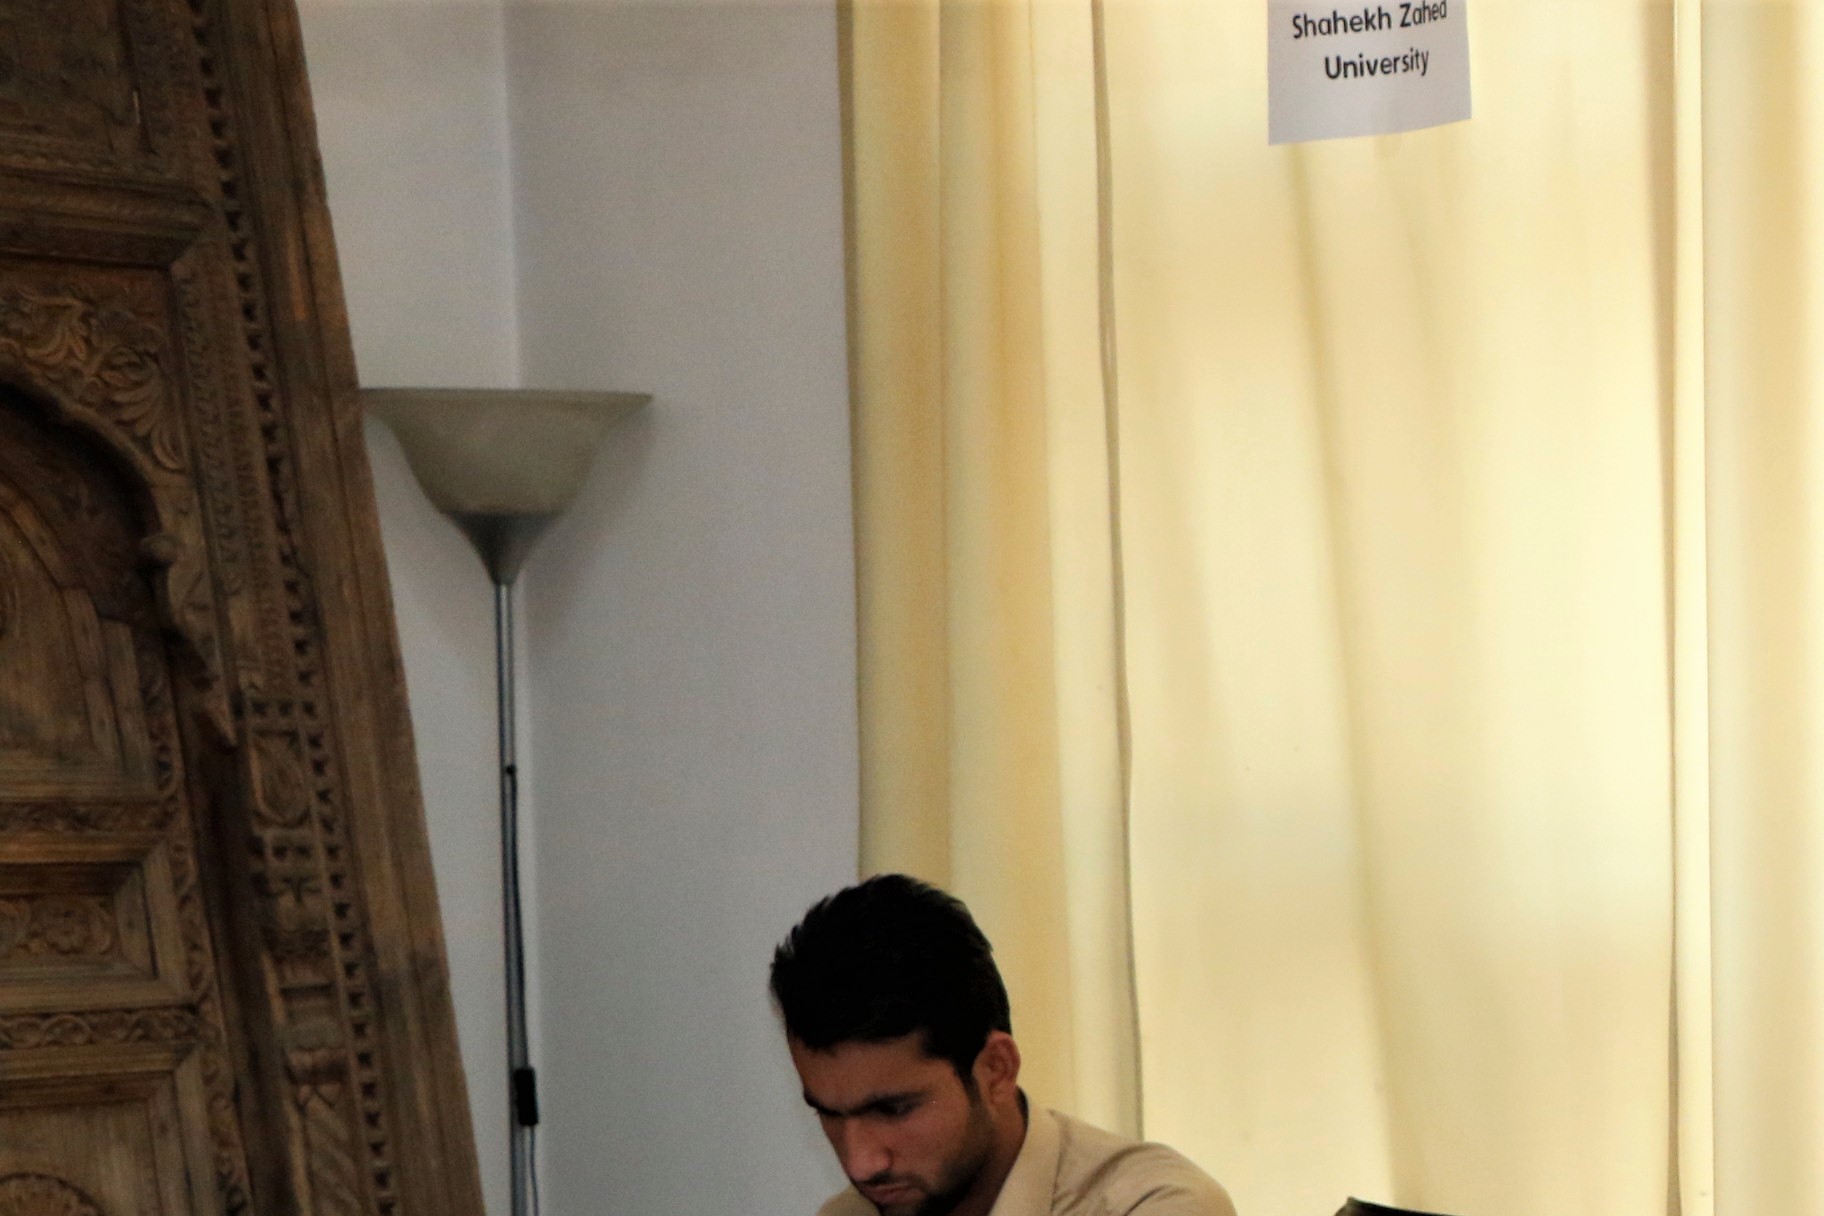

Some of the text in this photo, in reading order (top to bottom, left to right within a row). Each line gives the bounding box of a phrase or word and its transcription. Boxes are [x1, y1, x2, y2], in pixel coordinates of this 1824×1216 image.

[1292, 0, 1448, 39] Shahekh Zahed
[1324, 47, 1430, 79] University
